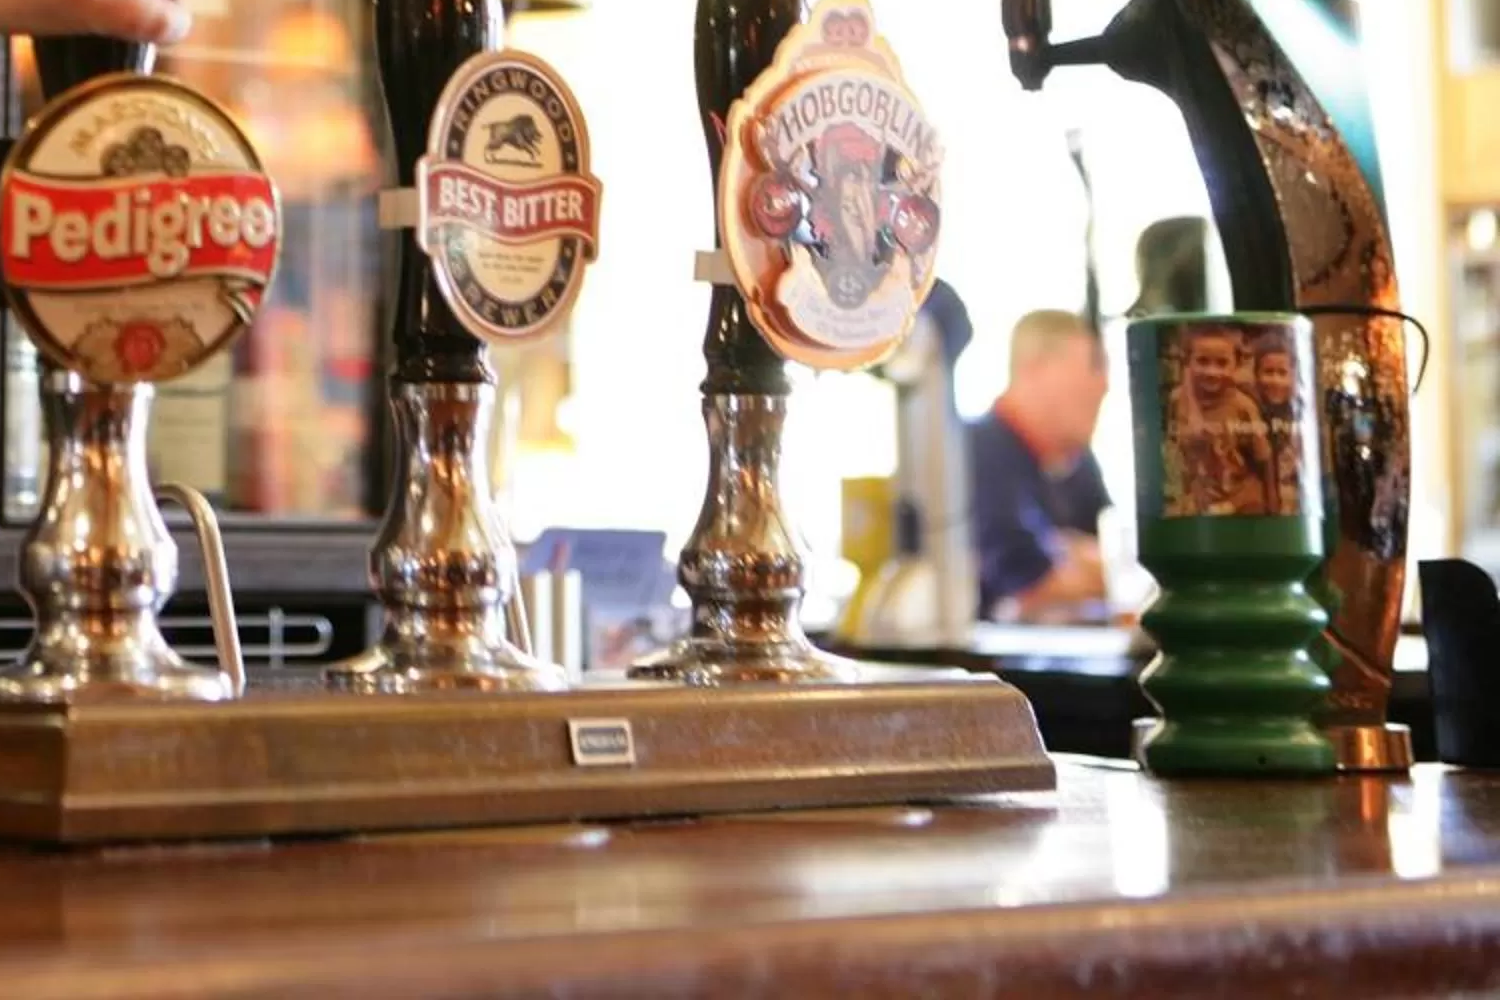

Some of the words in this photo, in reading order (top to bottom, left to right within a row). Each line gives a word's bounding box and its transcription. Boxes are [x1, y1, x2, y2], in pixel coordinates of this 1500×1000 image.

[454, 67, 574, 142] RINGWOOD
[781, 80, 936, 155] HOBGOBLIN
[11, 187, 275, 278] Pedigree
[439, 176, 498, 223] BEST
[503, 188, 585, 230] BITTER
